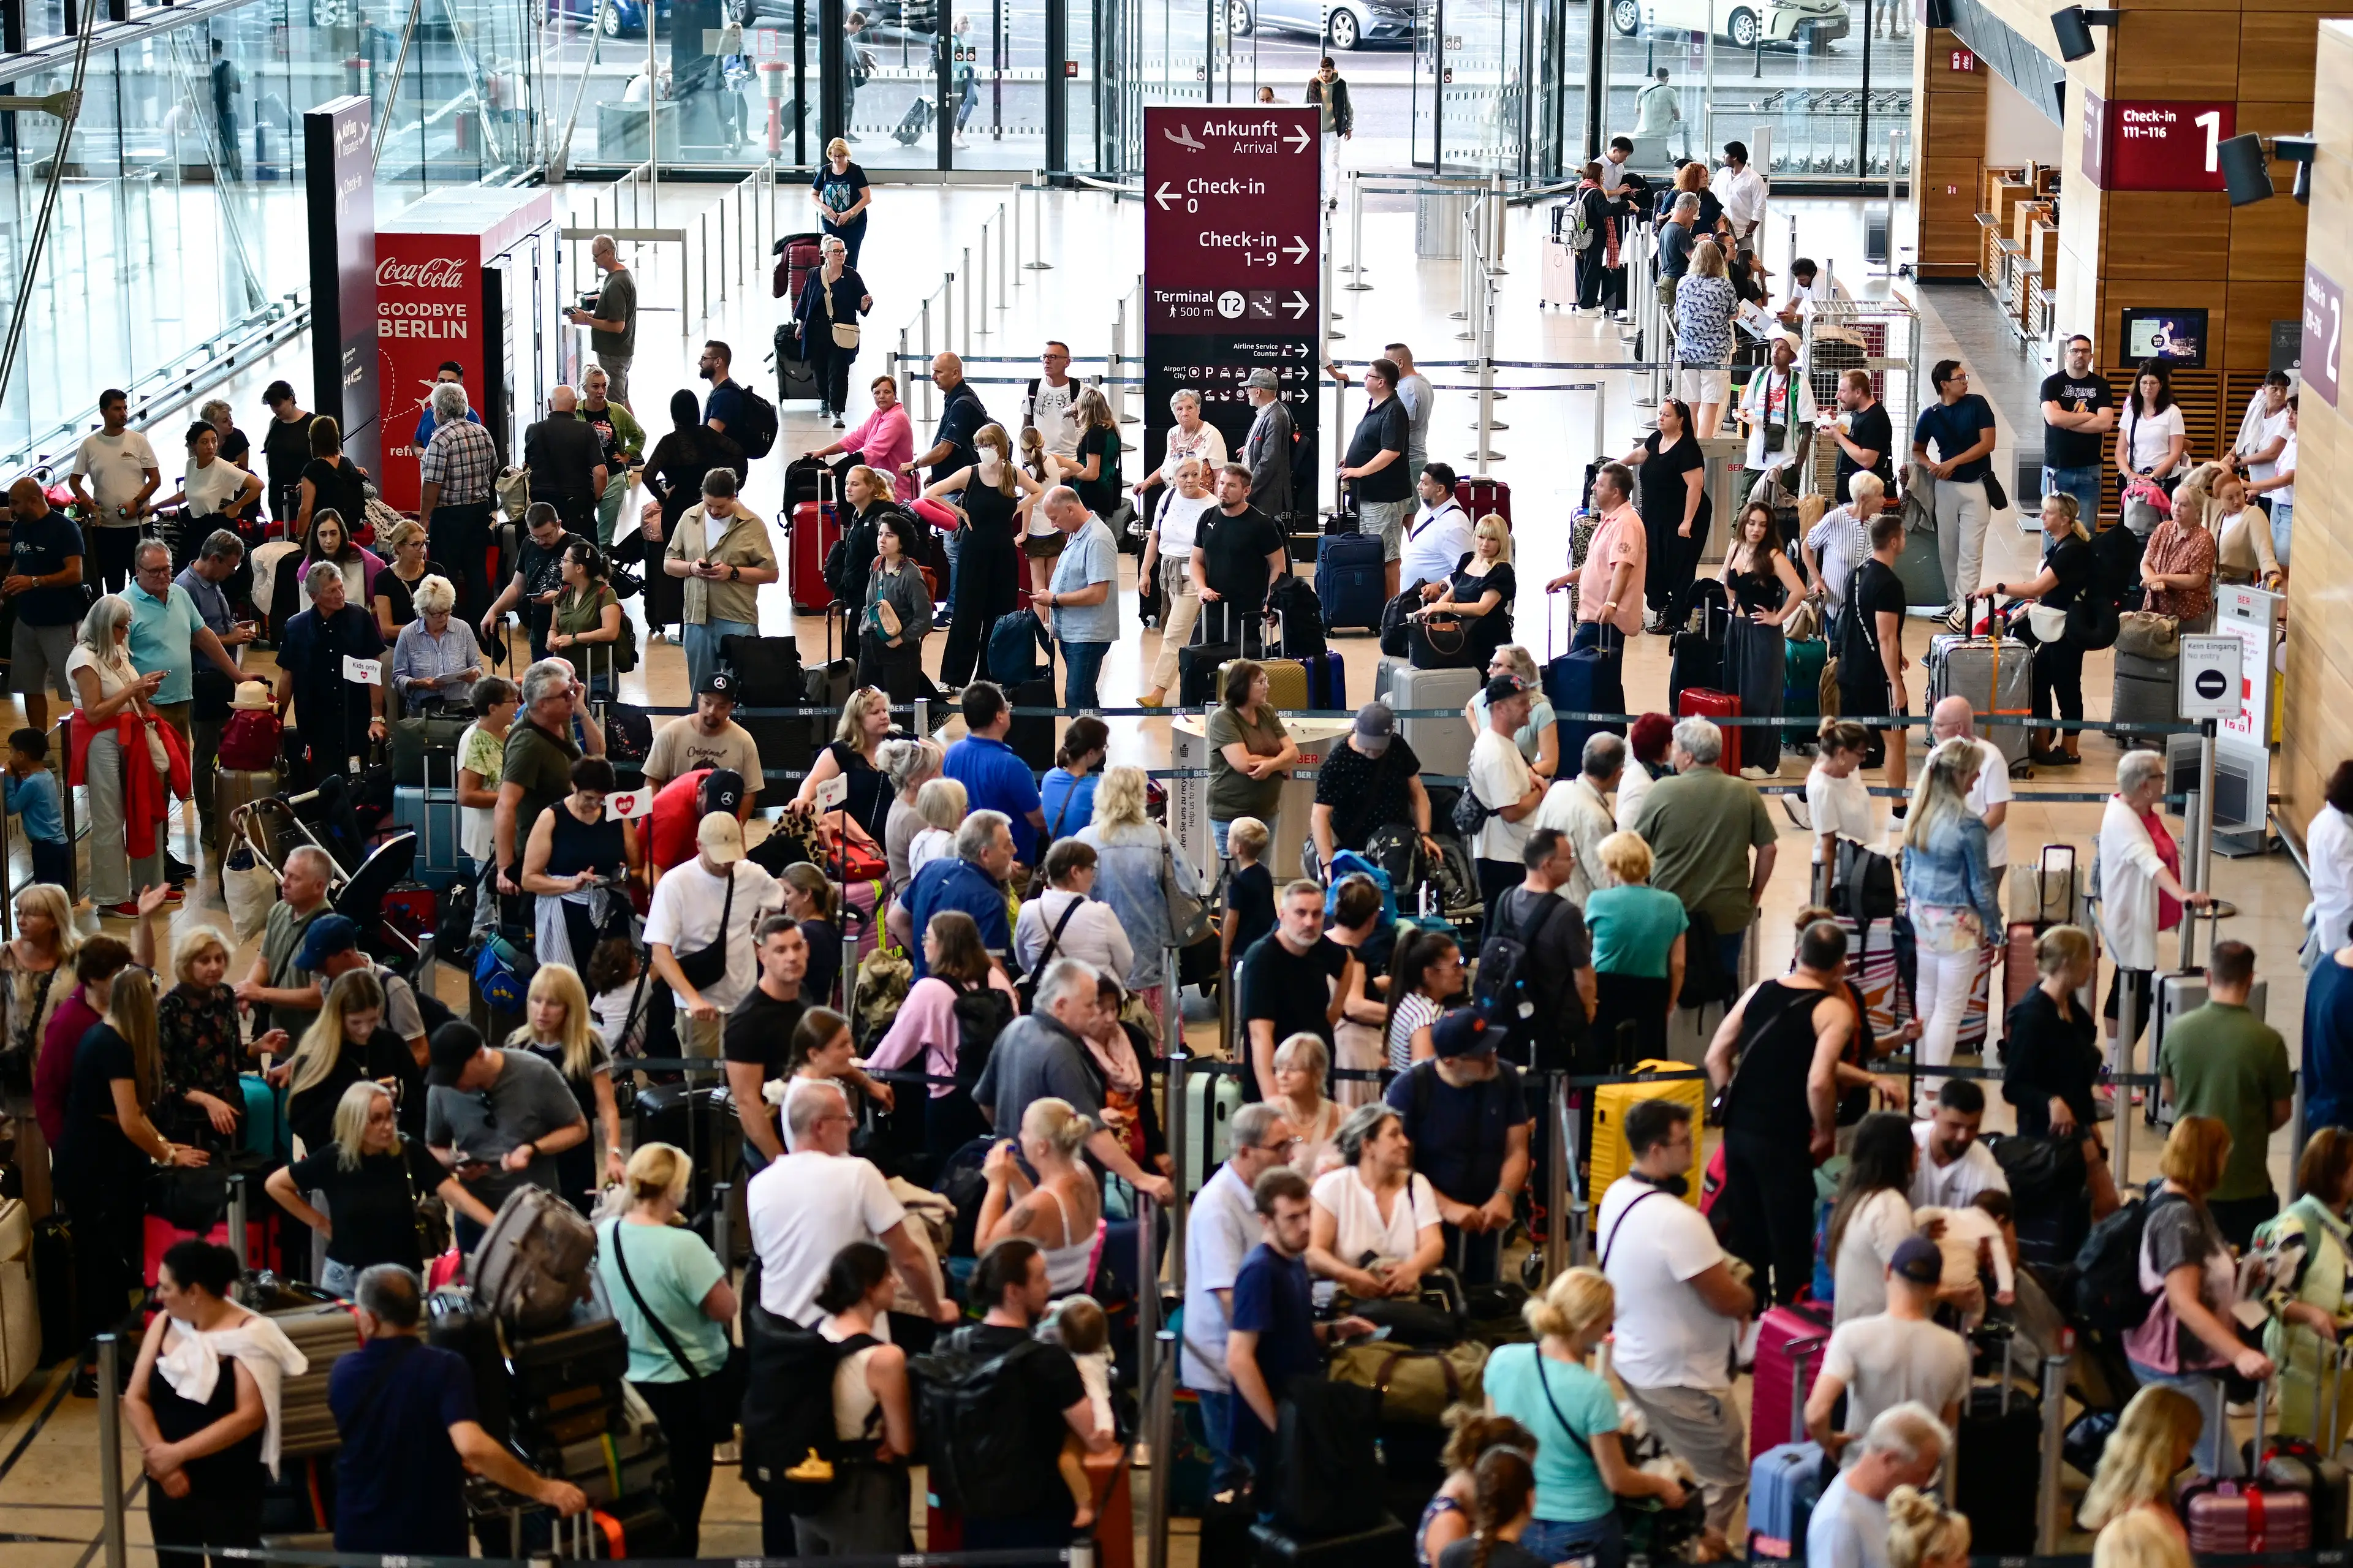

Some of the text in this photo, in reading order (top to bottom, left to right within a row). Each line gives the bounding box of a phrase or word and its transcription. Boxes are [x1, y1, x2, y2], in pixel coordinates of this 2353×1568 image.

[2123, 110, 2176, 123] Check-in
[343, 119, 356, 139] Abflug
[1202, 120, 1278, 137] Ankunft
[343, 140, 359, 158] Departure
[1233, 141, 1278, 154] Arrival
[2195, 112, 2220, 172] 1
[344, 172, 362, 194] Check-in
[1187, 178, 1265, 194] Check-in
[345, 200, 348, 214] 0
[1187, 198, 1198, 213] 0
[1199, 231, 1276, 247] Check-in
[376, 257, 468, 288] Coca-Cola
[1154, 290, 1214, 302] Terminal
[377, 302, 466, 317] GOODBYE
[1180, 307, 1200, 317] 500
[1221, 298, 1240, 311] T2
[377, 319, 468, 339] BERLIN
[2326, 297, 2340, 384] 2
[1164, 365, 1186, 374] Airport
[2061, 385, 2097, 398] LAKERS
[2237, 595, 2251, 605] BER
[2207, 643, 2237, 652] Eingang
[687, 746, 727, 758] Original
